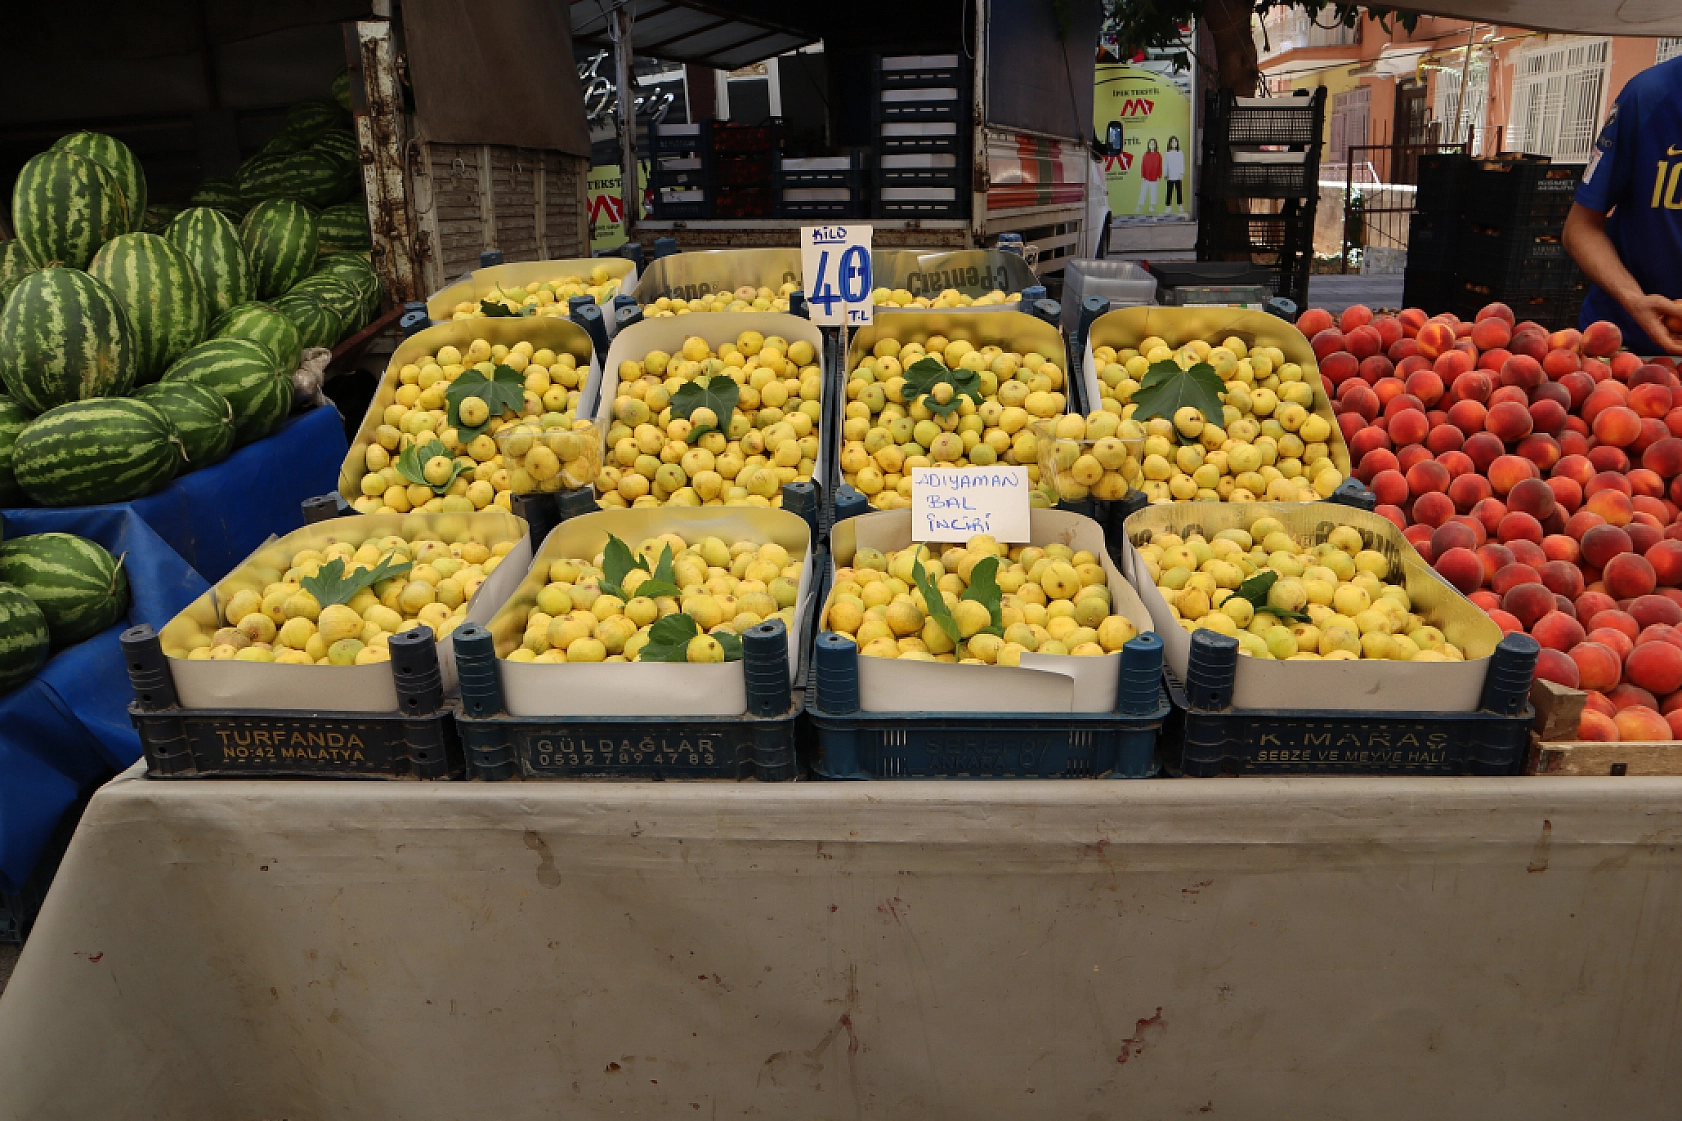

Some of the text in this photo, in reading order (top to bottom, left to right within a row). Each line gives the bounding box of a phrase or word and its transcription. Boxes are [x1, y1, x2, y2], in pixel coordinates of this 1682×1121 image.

[1651, 160, 1682, 210] 10
[806, 244, 872, 317] 40
[926, 494, 977, 511] BAL
[215, 729, 365, 748] TURFANDA
[281, 747, 365, 761] MALATYA
[539, 753, 594, 766] 0532
[1257, 750, 1312, 762] SEBZE
[1318, 751, 1340, 762] VE
